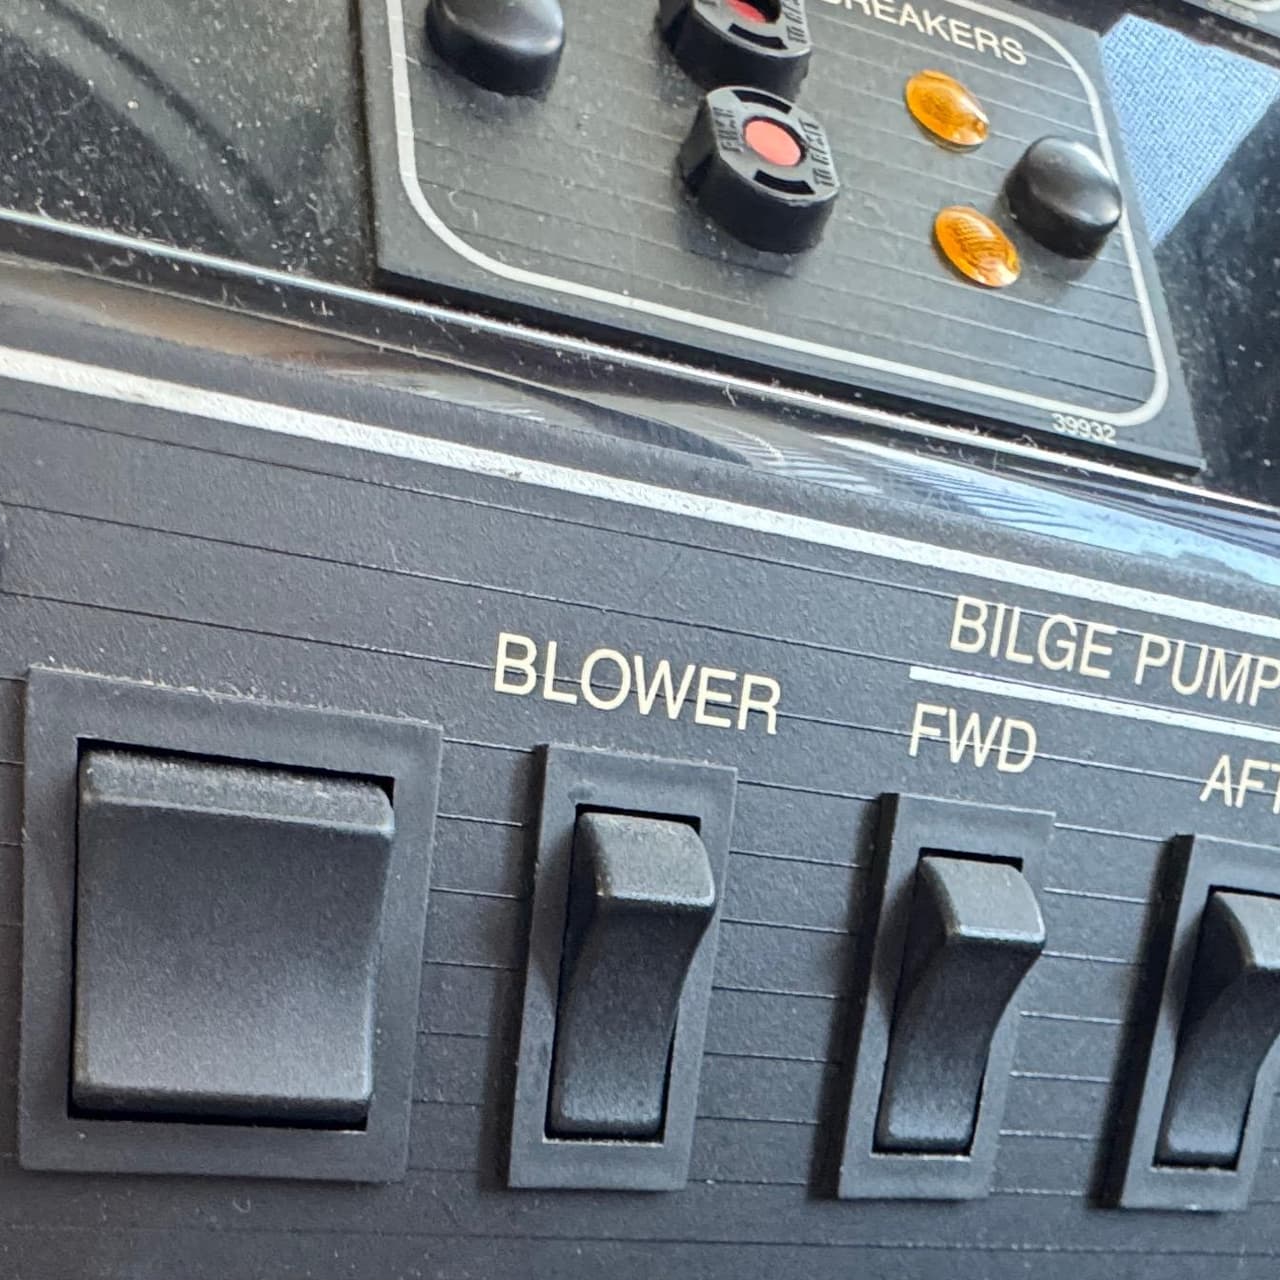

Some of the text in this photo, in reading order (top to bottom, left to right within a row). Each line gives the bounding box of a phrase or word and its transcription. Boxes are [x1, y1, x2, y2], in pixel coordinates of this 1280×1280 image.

[828, 0, 1028, 66] REAKERS
[1051, 412, 1117, 445] 39932
[950, 596, 1116, 678] BILGE
[493, 632, 782, 735] BLOWER
[908, 703, 1038, 774] FWD
